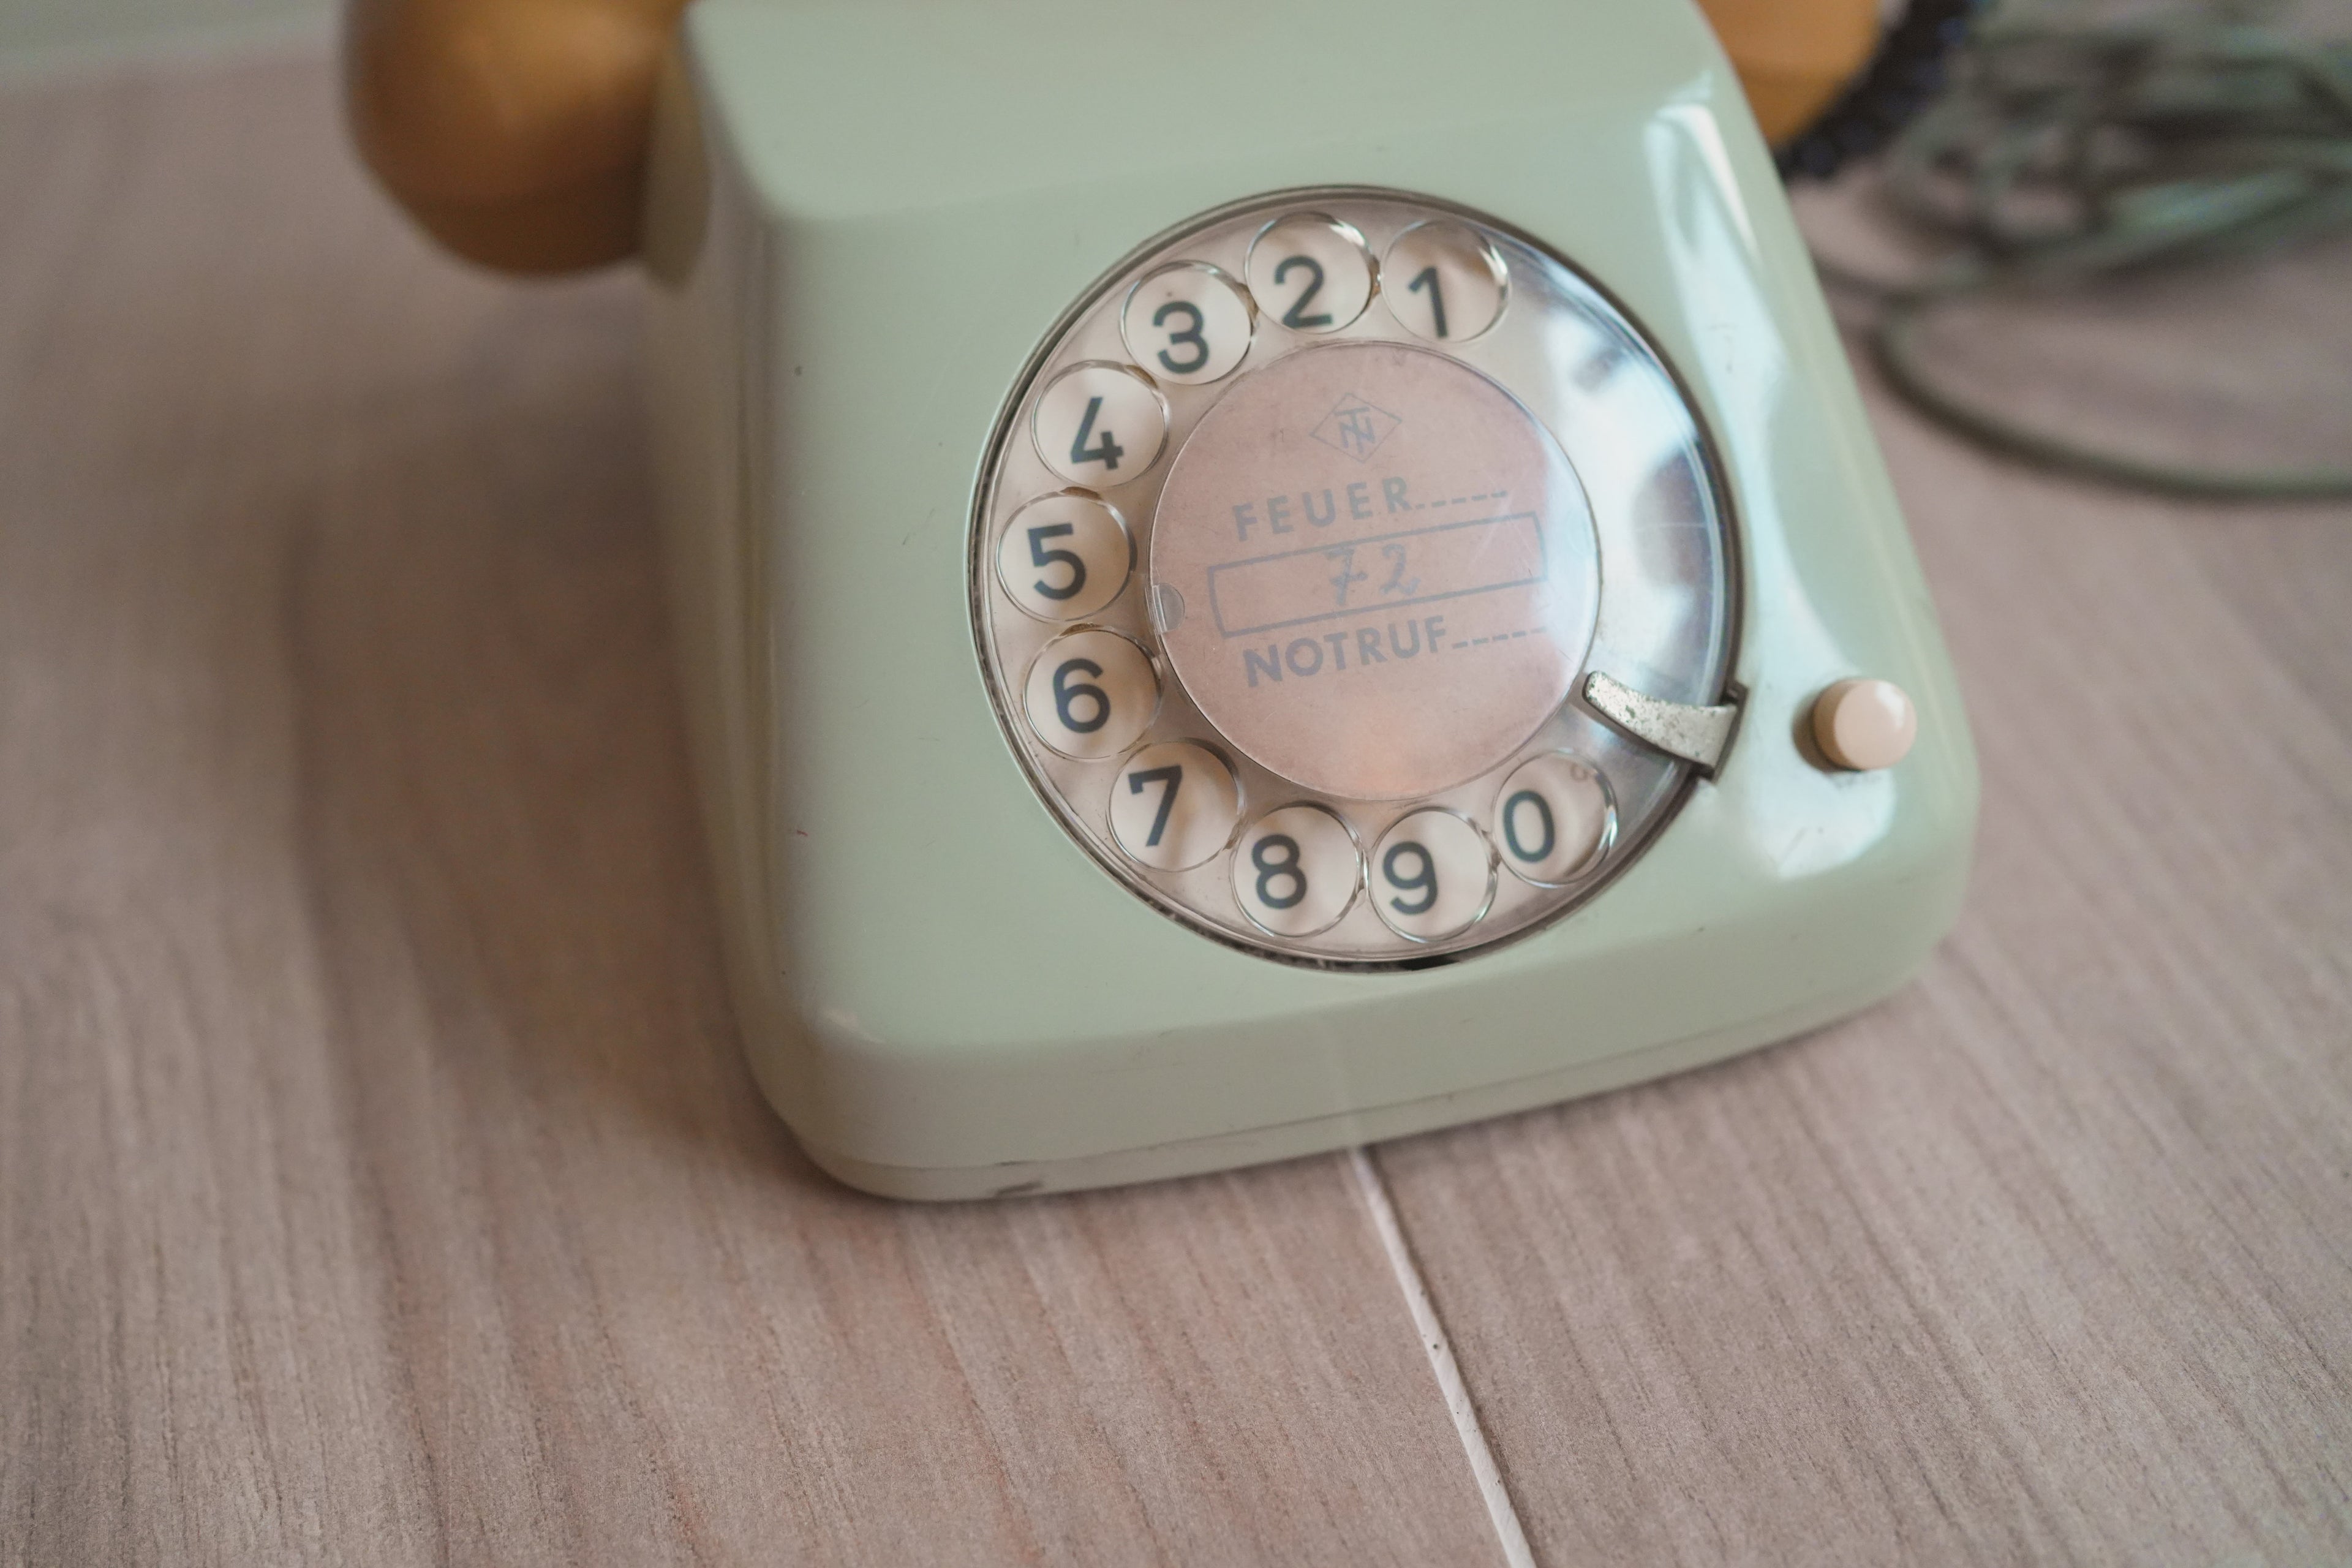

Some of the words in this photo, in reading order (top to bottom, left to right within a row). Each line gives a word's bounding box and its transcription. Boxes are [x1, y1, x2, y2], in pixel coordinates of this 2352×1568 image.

[1274, 254, 1332, 331] 2
[1408, 264, 1449, 339] 1
[1153, 300, 1210, 375] 3
[1071, 396, 1125, 472] 4
[1028, 522, 1087, 600] 5
[1053, 657, 1112, 734] 6
[1128, 765, 1183, 846] 7
[1502, 789, 1556, 864] 0
[1251, 834, 1308, 910] 8
[1382, 839, 1439, 915] 9
